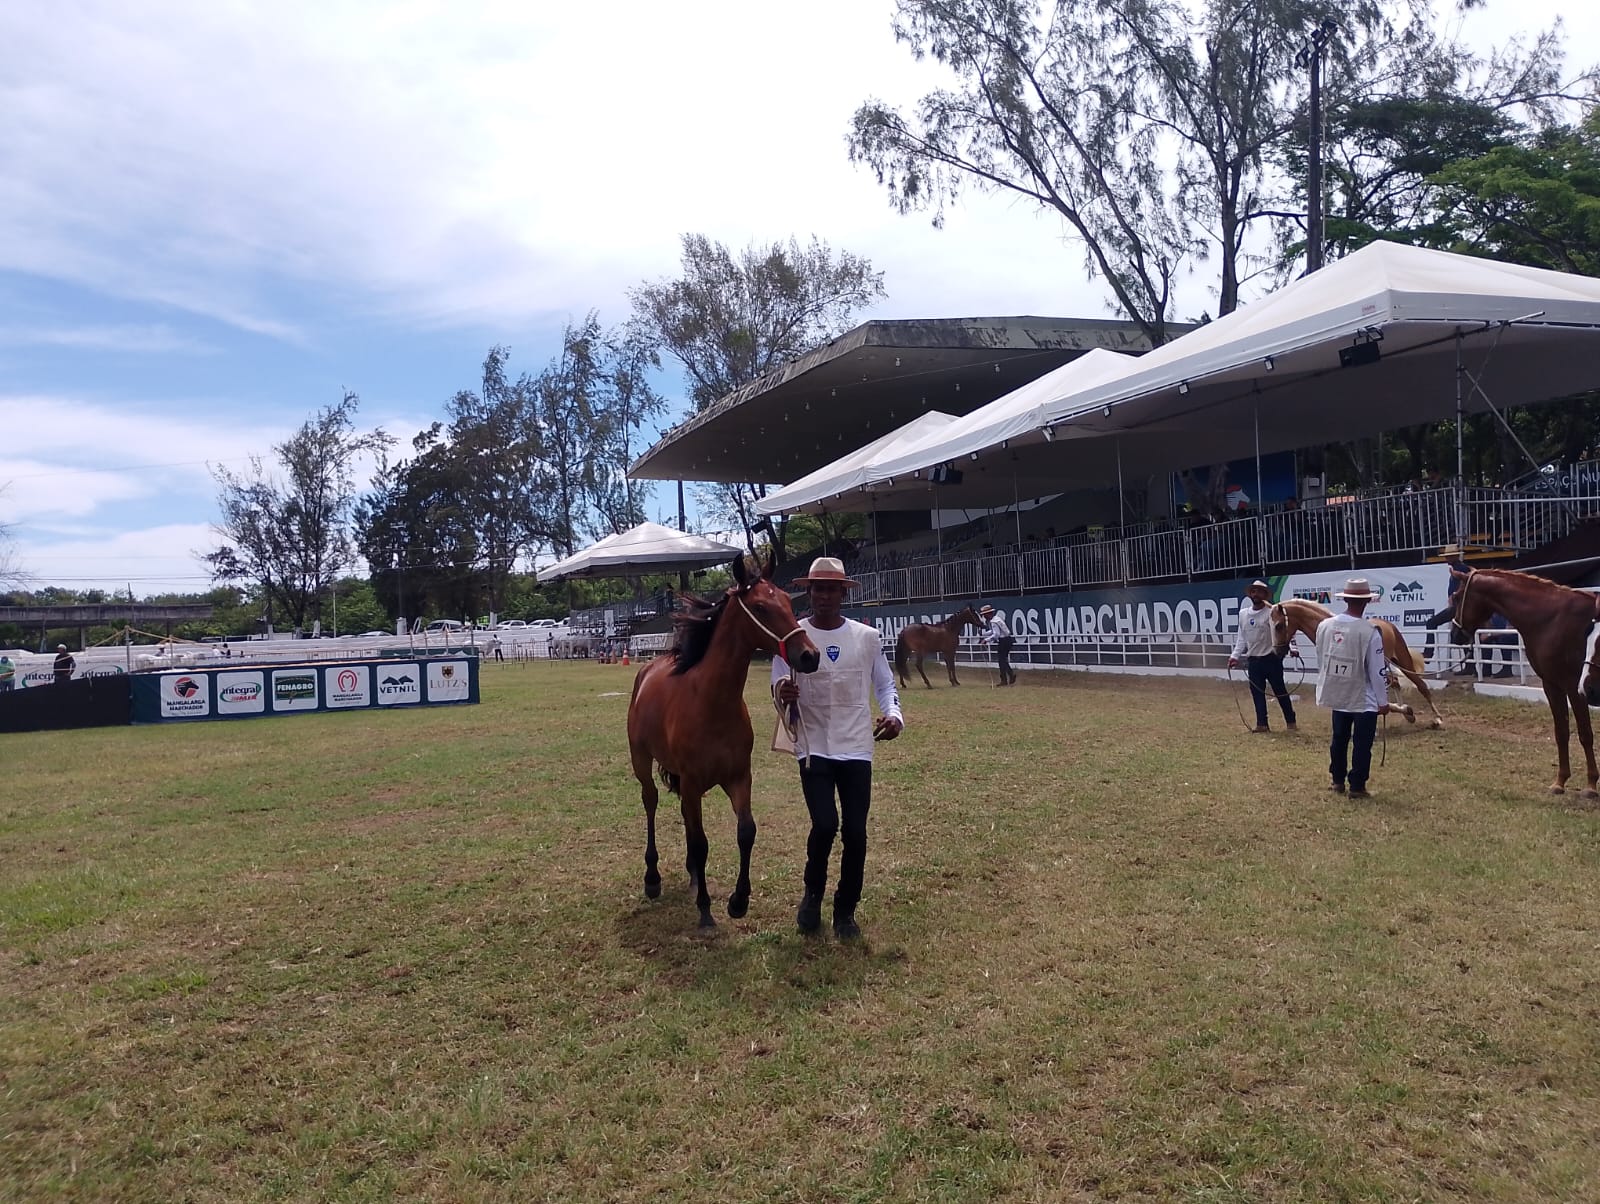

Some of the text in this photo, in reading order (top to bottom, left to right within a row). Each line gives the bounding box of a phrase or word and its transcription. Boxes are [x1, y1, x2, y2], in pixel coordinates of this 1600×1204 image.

[1535, 476, 1576, 489] ESPAÇ
[1390, 594, 1424, 602] VETNIL
[1012, 608, 1041, 645] OS
[1335, 664, 1347, 675] 17
[25, 672, 55, 682] integr
[223, 686, 258, 695] integral
[277, 683, 313, 691] FENAGRO
[380, 686, 416, 694] VETNIL
